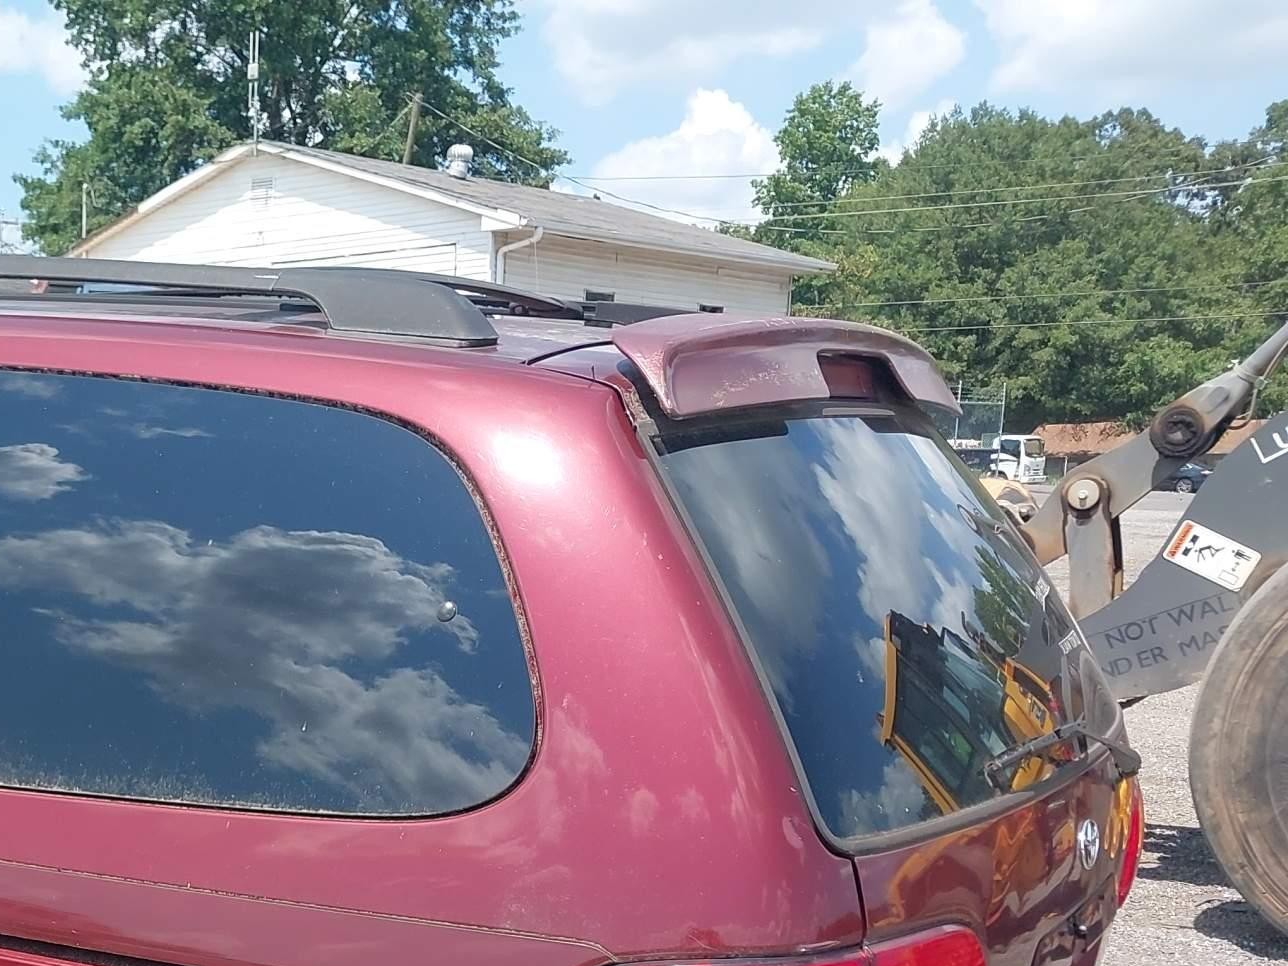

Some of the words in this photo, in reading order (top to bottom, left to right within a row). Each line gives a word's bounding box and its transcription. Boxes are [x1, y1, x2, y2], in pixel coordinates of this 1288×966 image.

[1104, 616, 1158, 649] NOT
[1167, 596, 1235, 627] WAL
[1101, 646, 1169, 678] NDER
